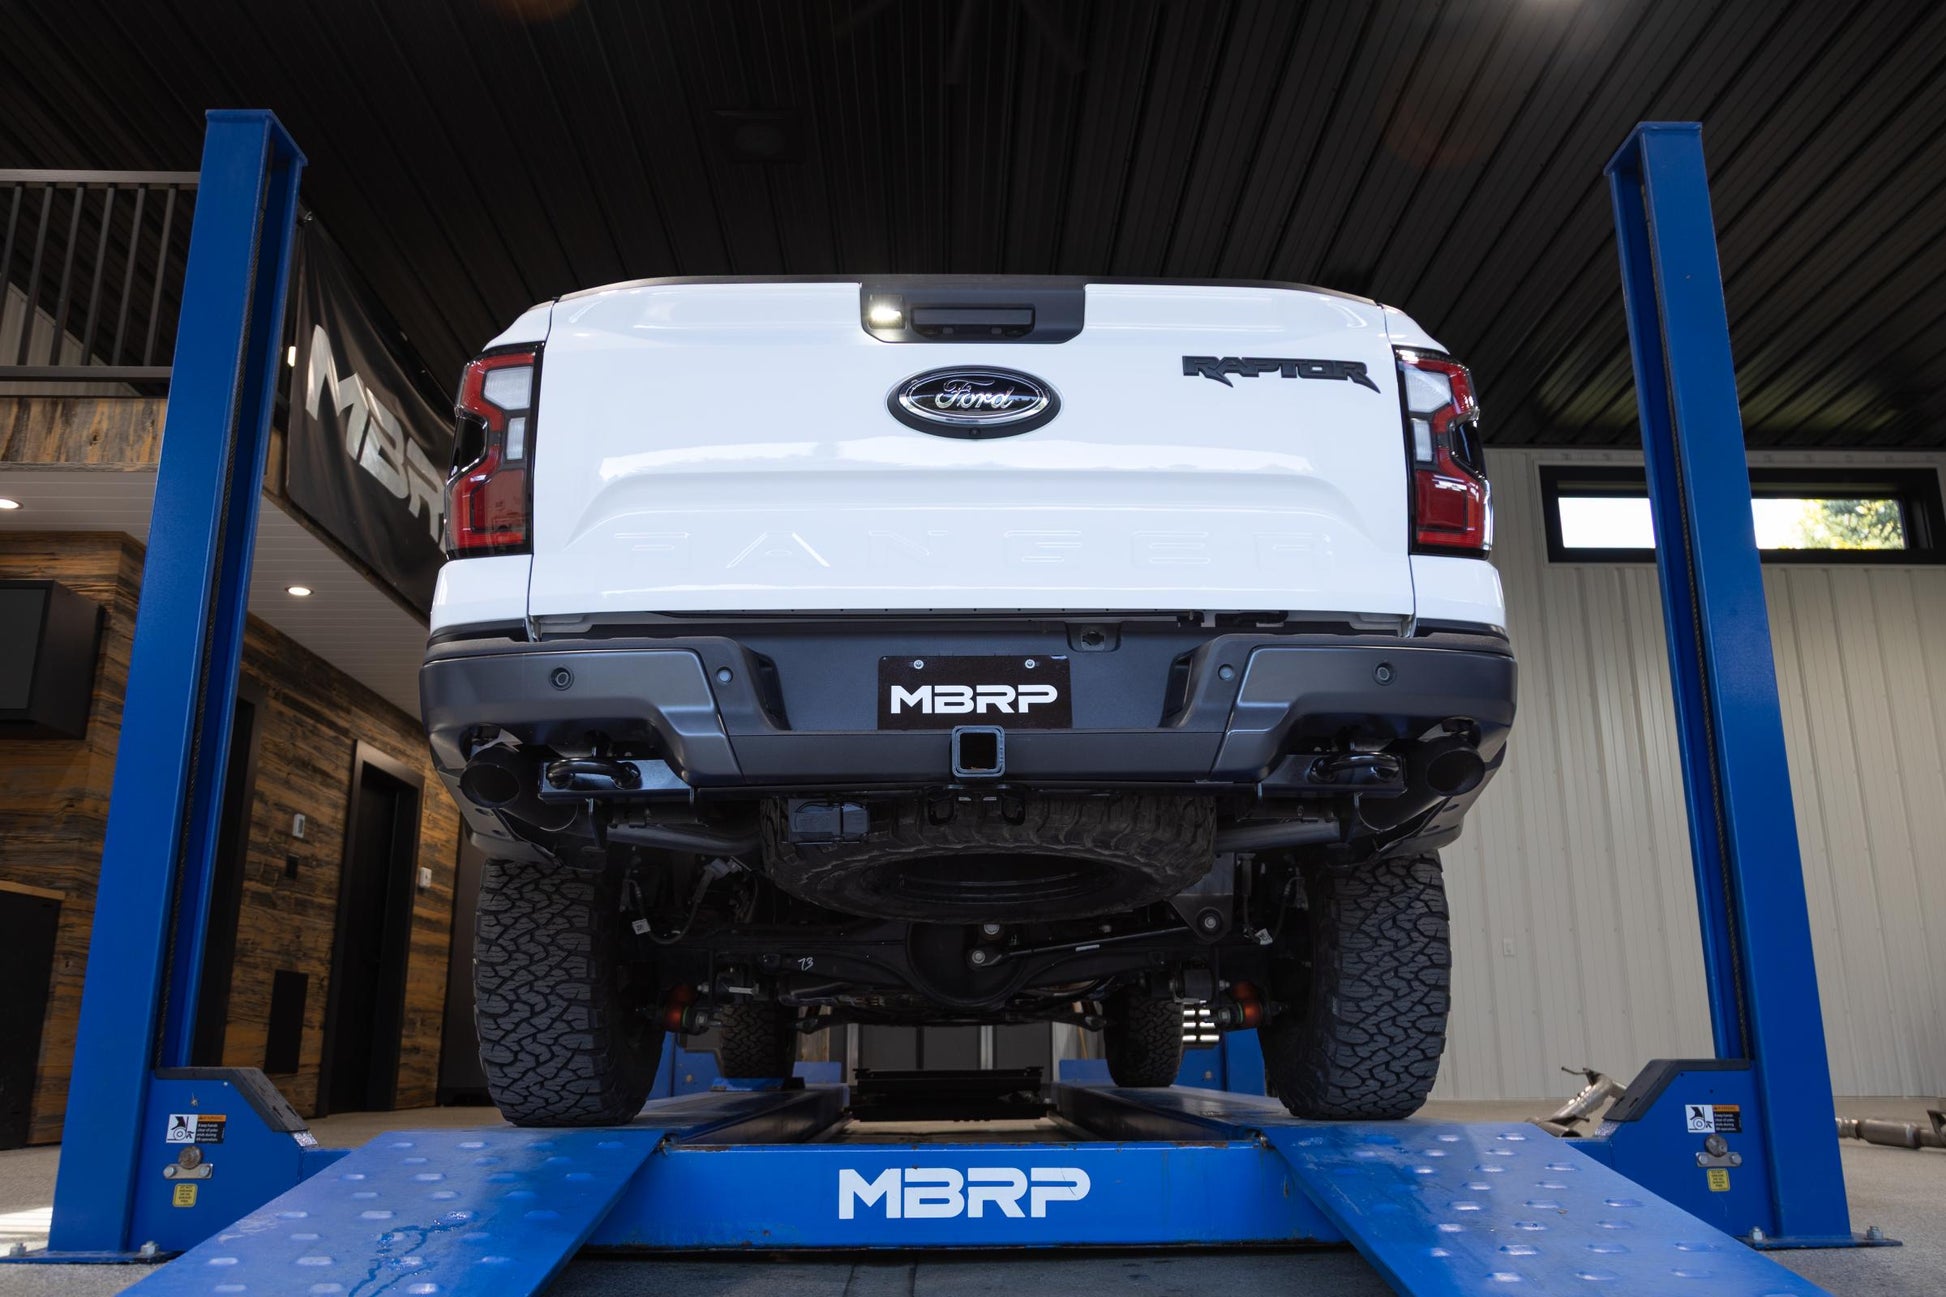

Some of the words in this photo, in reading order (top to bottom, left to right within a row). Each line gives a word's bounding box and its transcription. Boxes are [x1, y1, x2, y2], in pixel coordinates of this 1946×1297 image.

[934, 379, 1015, 409] Ford
[1182, 355, 1381, 394] RAPTOR
[305, 324, 447, 554] MBR
[890, 684, 1058, 714] MBRP
[838, 1167, 1091, 1219] MBRP
